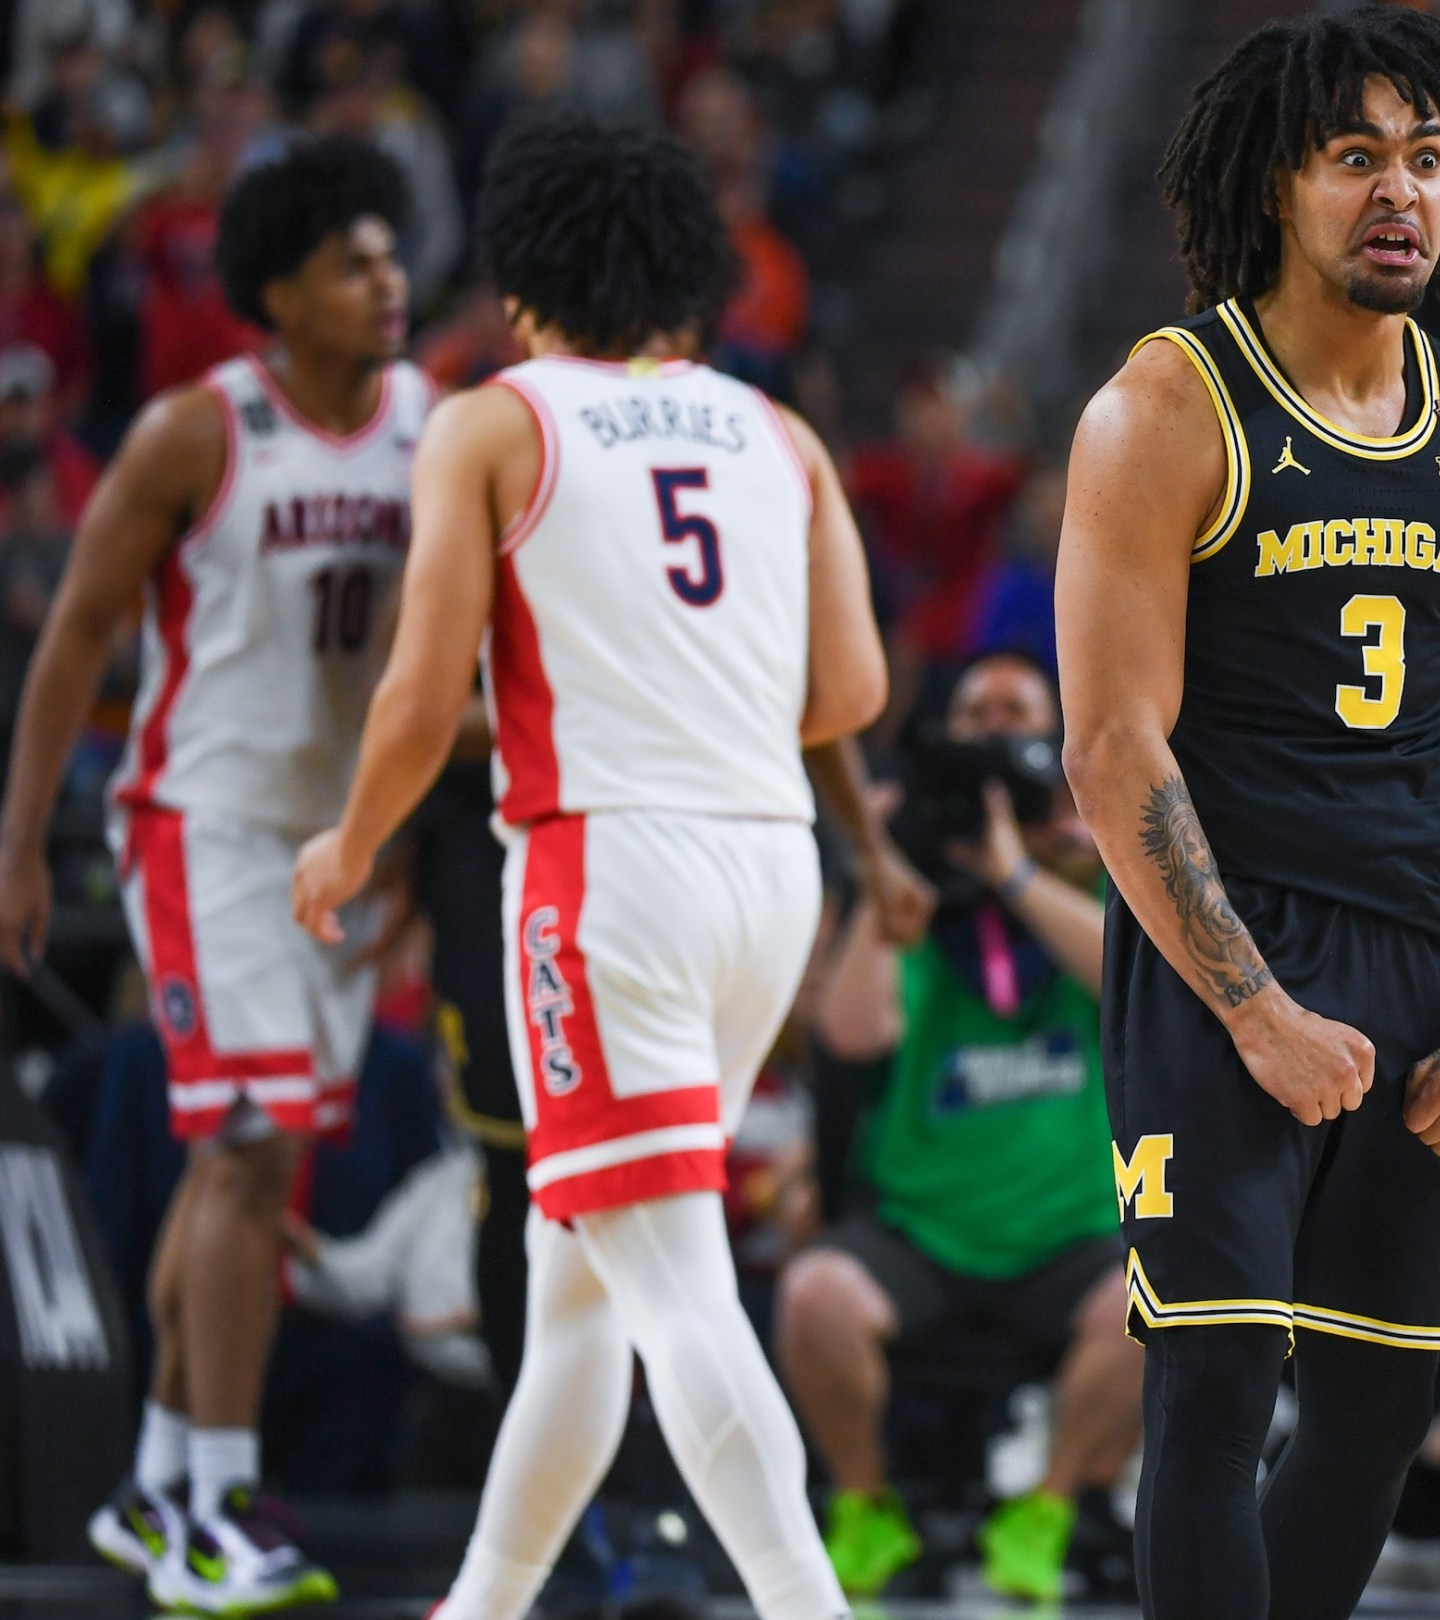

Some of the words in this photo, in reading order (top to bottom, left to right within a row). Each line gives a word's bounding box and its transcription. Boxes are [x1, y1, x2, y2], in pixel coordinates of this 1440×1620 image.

[579, 397, 746, 453] BURRIES
[259, 495, 412, 557] ARIZON
[649, 466, 724, 608] 5
[310, 562, 372, 656] 10
[1335, 594, 1406, 729] 3
[523, 905, 583, 1097] CATS
[1112, 1133, 1174, 1223] M
